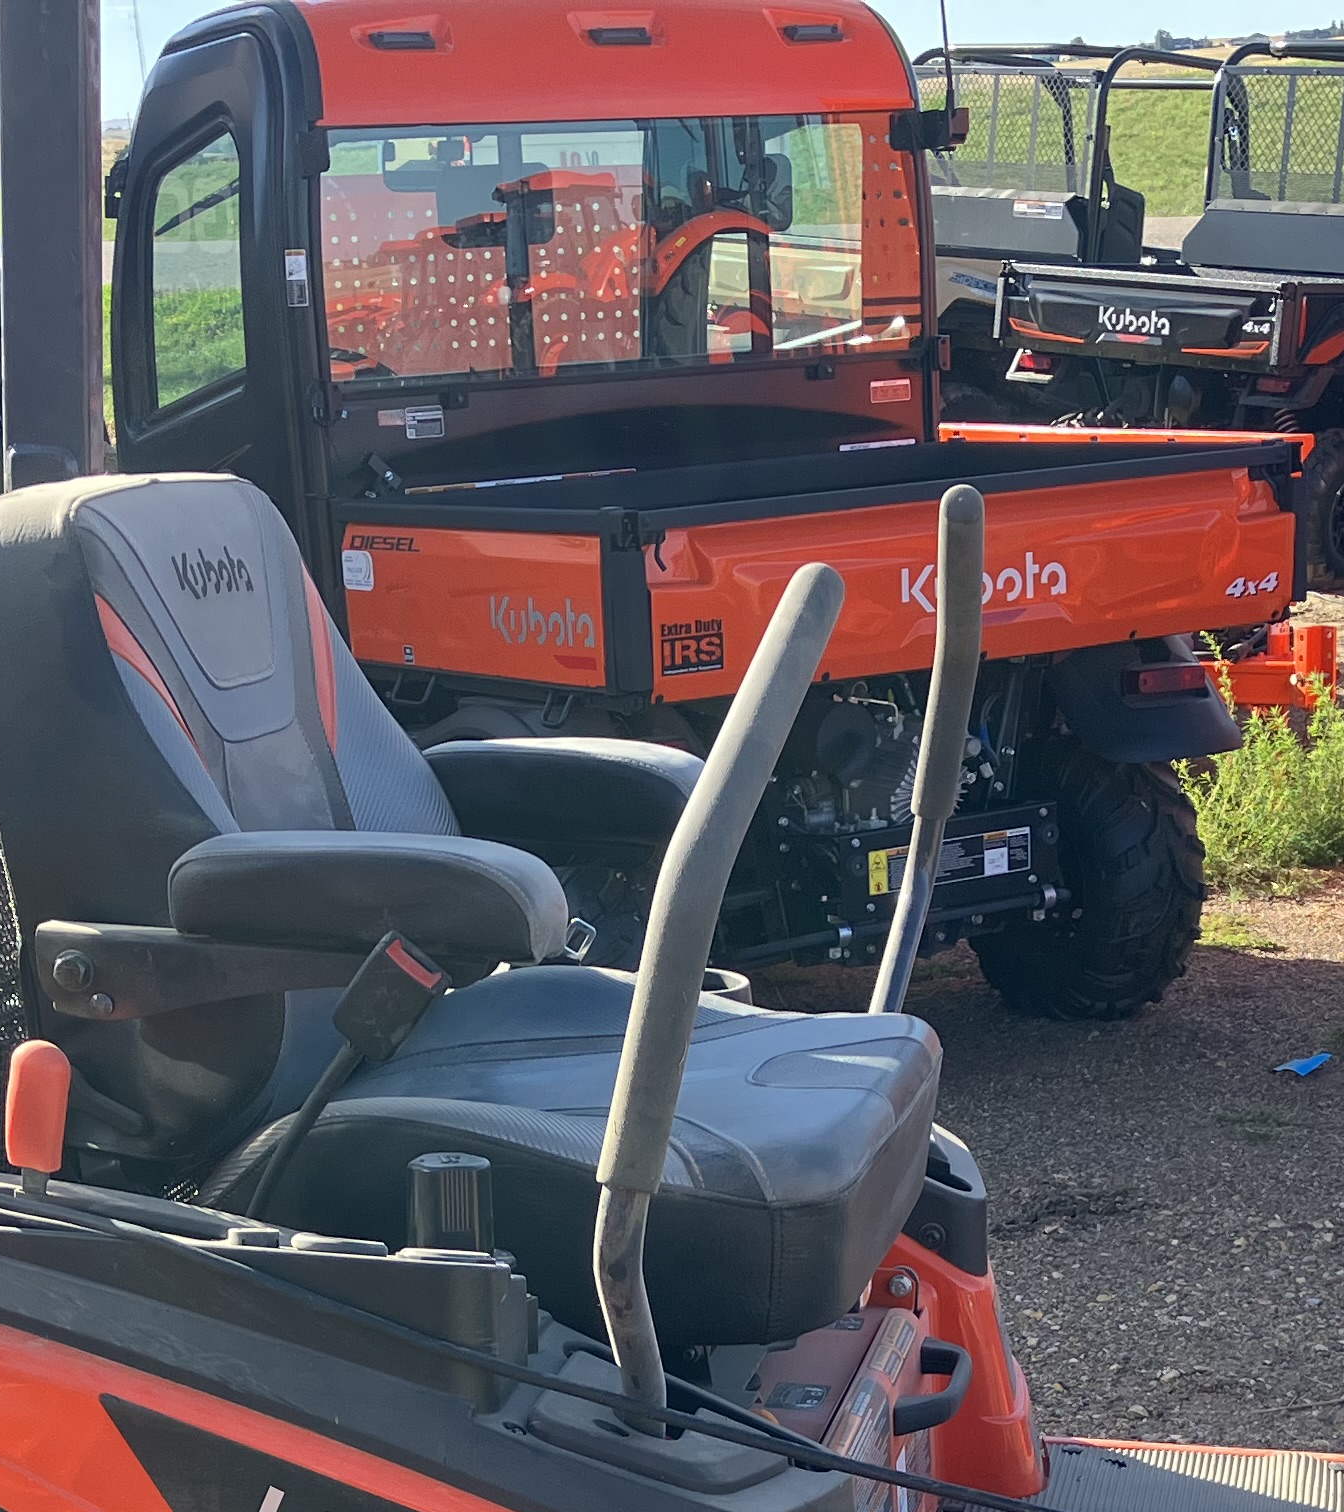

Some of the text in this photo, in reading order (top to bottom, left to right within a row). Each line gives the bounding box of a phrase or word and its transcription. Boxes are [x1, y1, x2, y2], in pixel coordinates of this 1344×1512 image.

[1098, 305, 1171, 335] Kubota
[1242, 319, 1271, 334] 4x4
[349, 535, 420, 552] DIESEL
[171, 545, 254, 599] Kubota
[1225, 571, 1279, 599] 4x4
[489, 595, 595, 648] Kubota
[660, 619, 722, 637] Extra Duty
[663, 636, 722, 667] IRS
